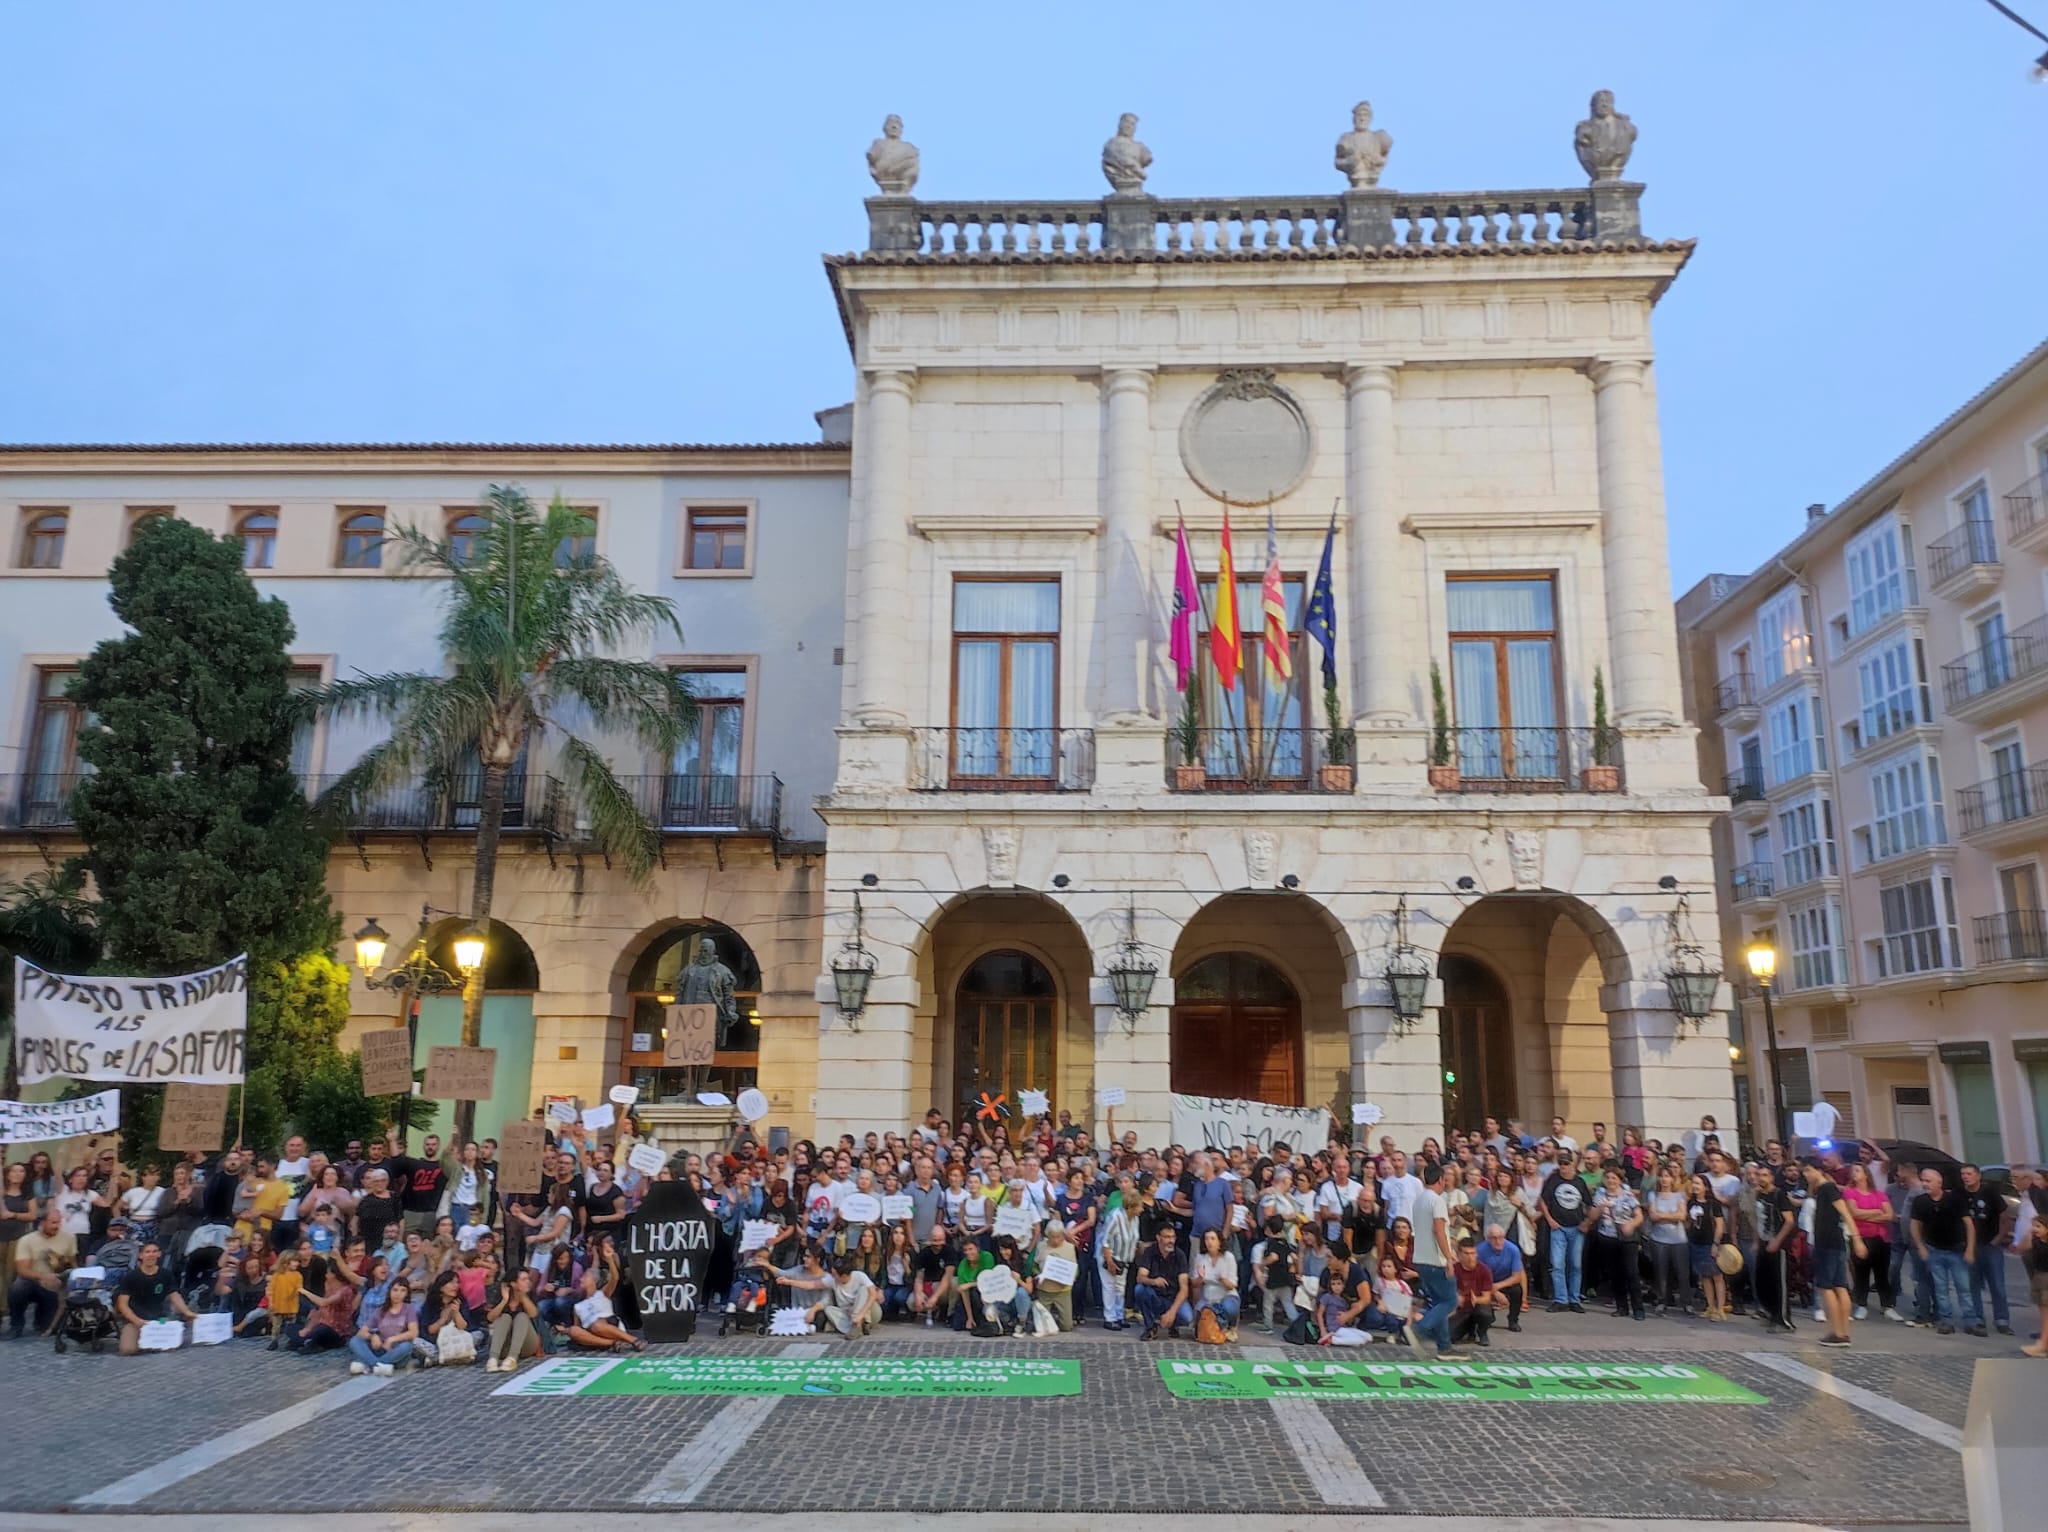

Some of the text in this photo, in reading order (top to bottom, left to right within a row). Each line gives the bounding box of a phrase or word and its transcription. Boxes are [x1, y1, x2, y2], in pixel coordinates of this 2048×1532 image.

[96, 1015, 146, 1032] ALS
[675, 1007, 706, 1032] NO
[1202, 1120, 1234, 1151] NO
[631, 1220, 710, 1254] L'HORTA
[645, 1257, 691, 1279] DE LA
[640, 1283, 698, 1314] SAFOR
[813, 1359, 845, 1367] DE
[1170, 1362, 1700, 1379] NO A LA PROLONGACIÓ
[840, 1374, 894, 1382] QUE
[1262, 1375, 1642, 1391] DE LA CV-60
